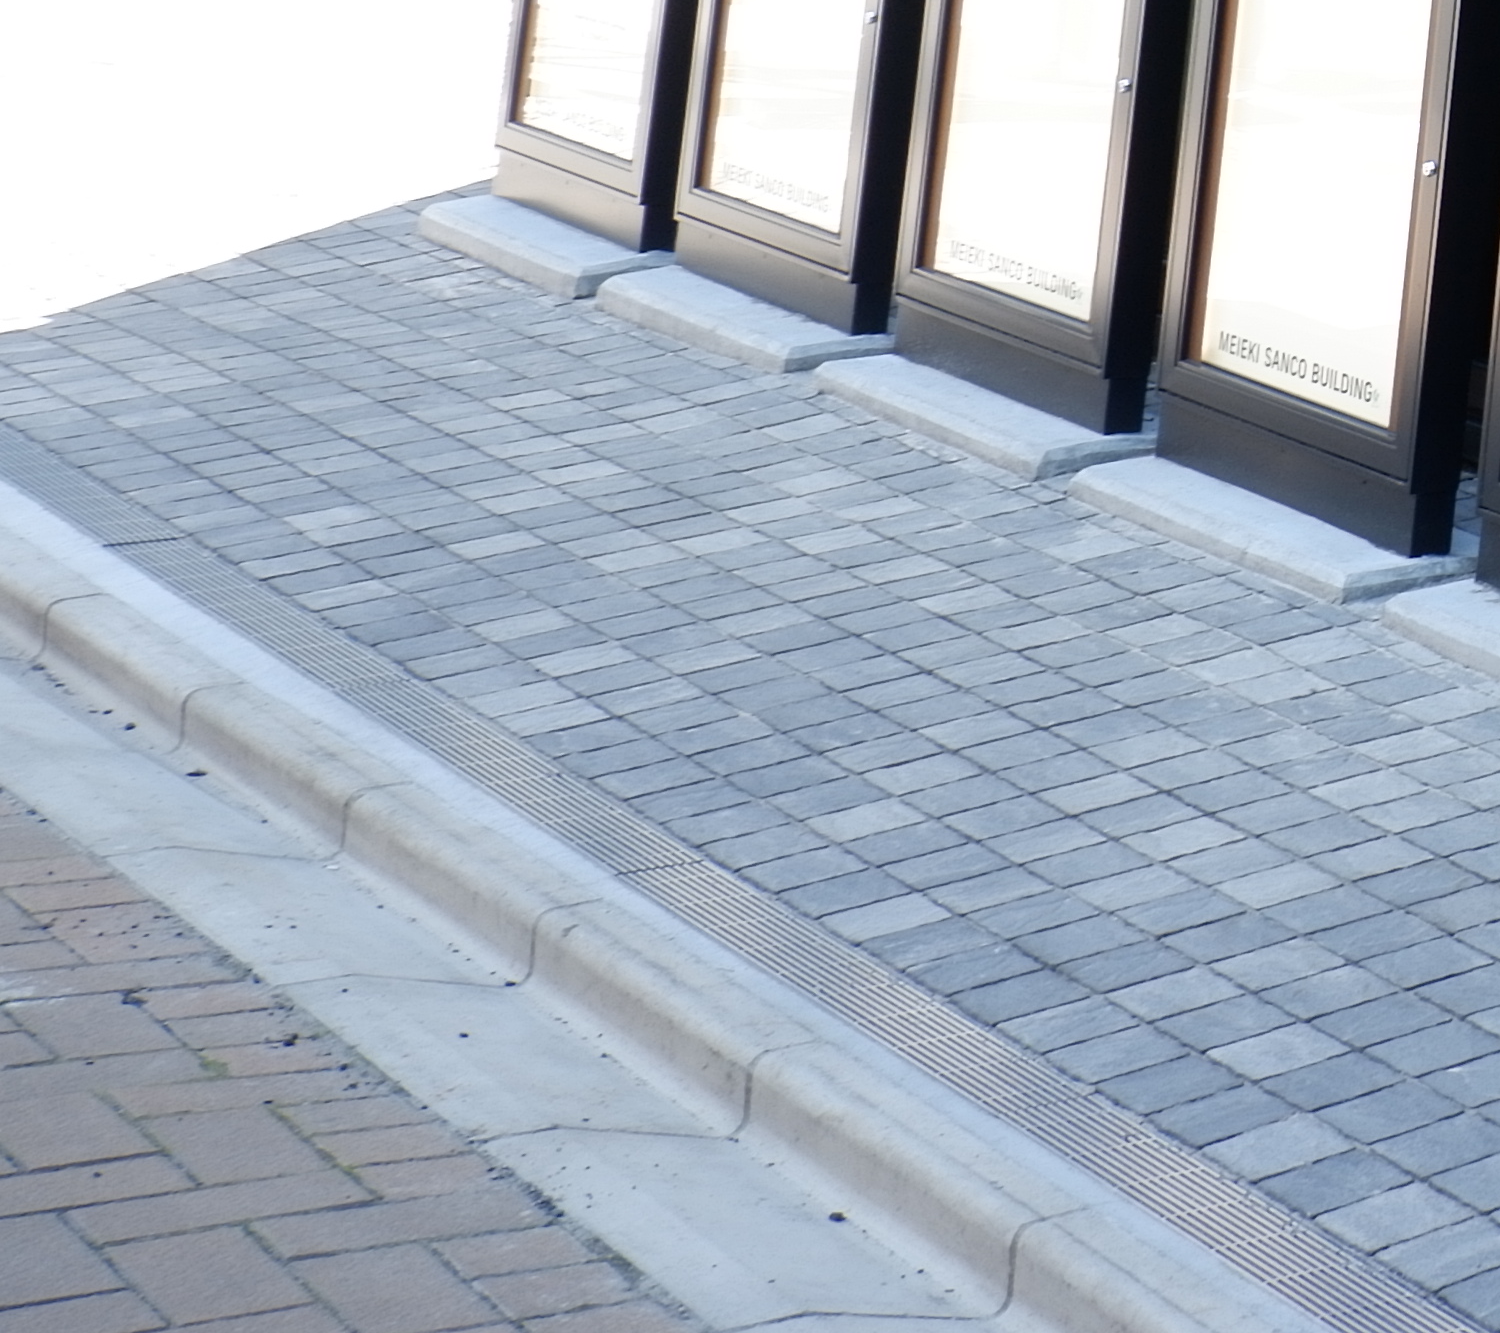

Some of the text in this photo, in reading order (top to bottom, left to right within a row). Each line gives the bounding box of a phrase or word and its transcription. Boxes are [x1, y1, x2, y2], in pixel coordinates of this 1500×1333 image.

[1218, 331, 1373, 403] MEIEKI SANCO BUILDING
